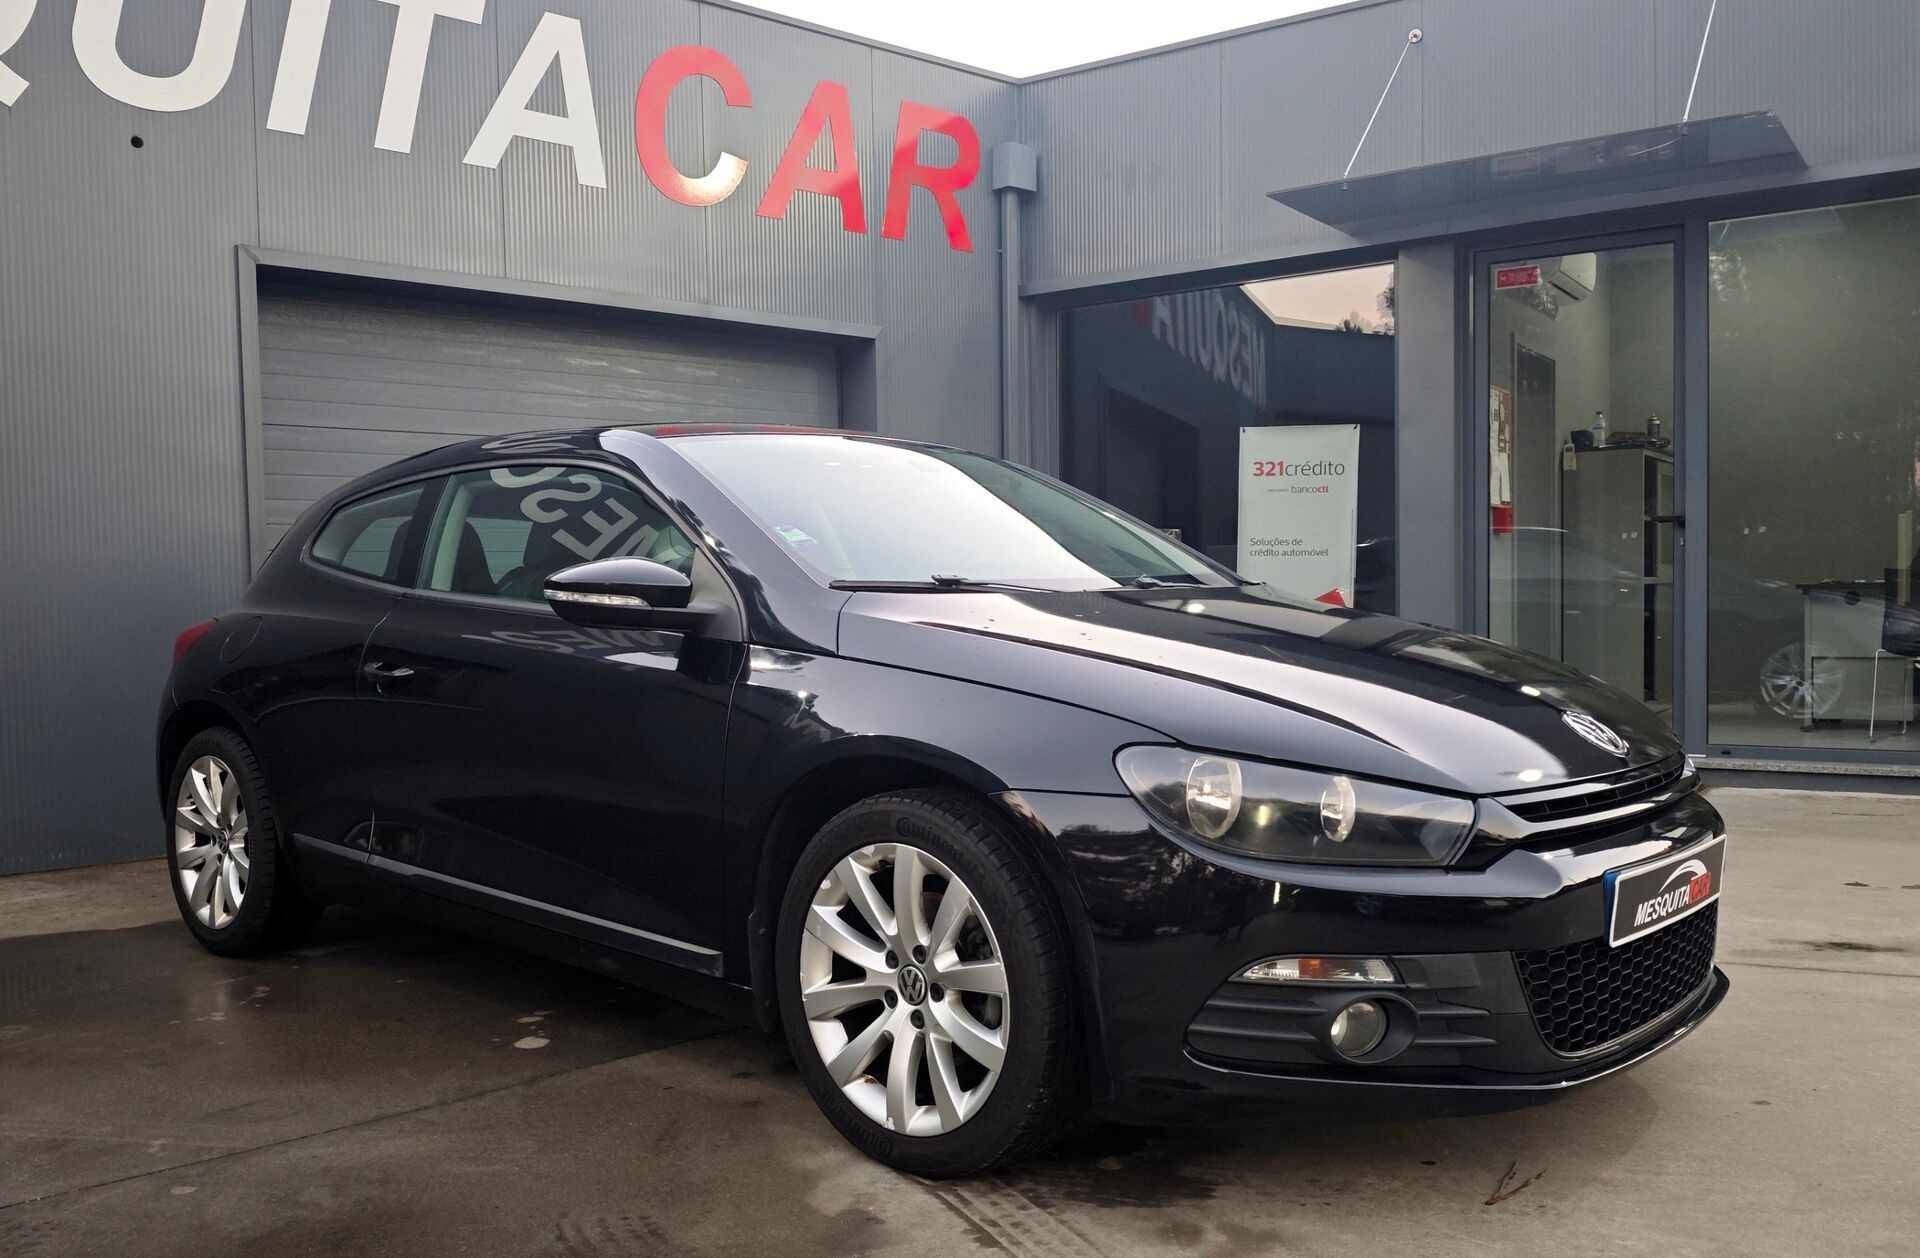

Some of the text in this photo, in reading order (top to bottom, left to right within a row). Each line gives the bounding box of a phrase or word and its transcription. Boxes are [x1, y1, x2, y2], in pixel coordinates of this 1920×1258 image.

[0, 0, 981, 253] UITACAR
[1250, 537, 1304, 548] Soluções de
[1250, 548, 1329, 557] crédito automóvel
